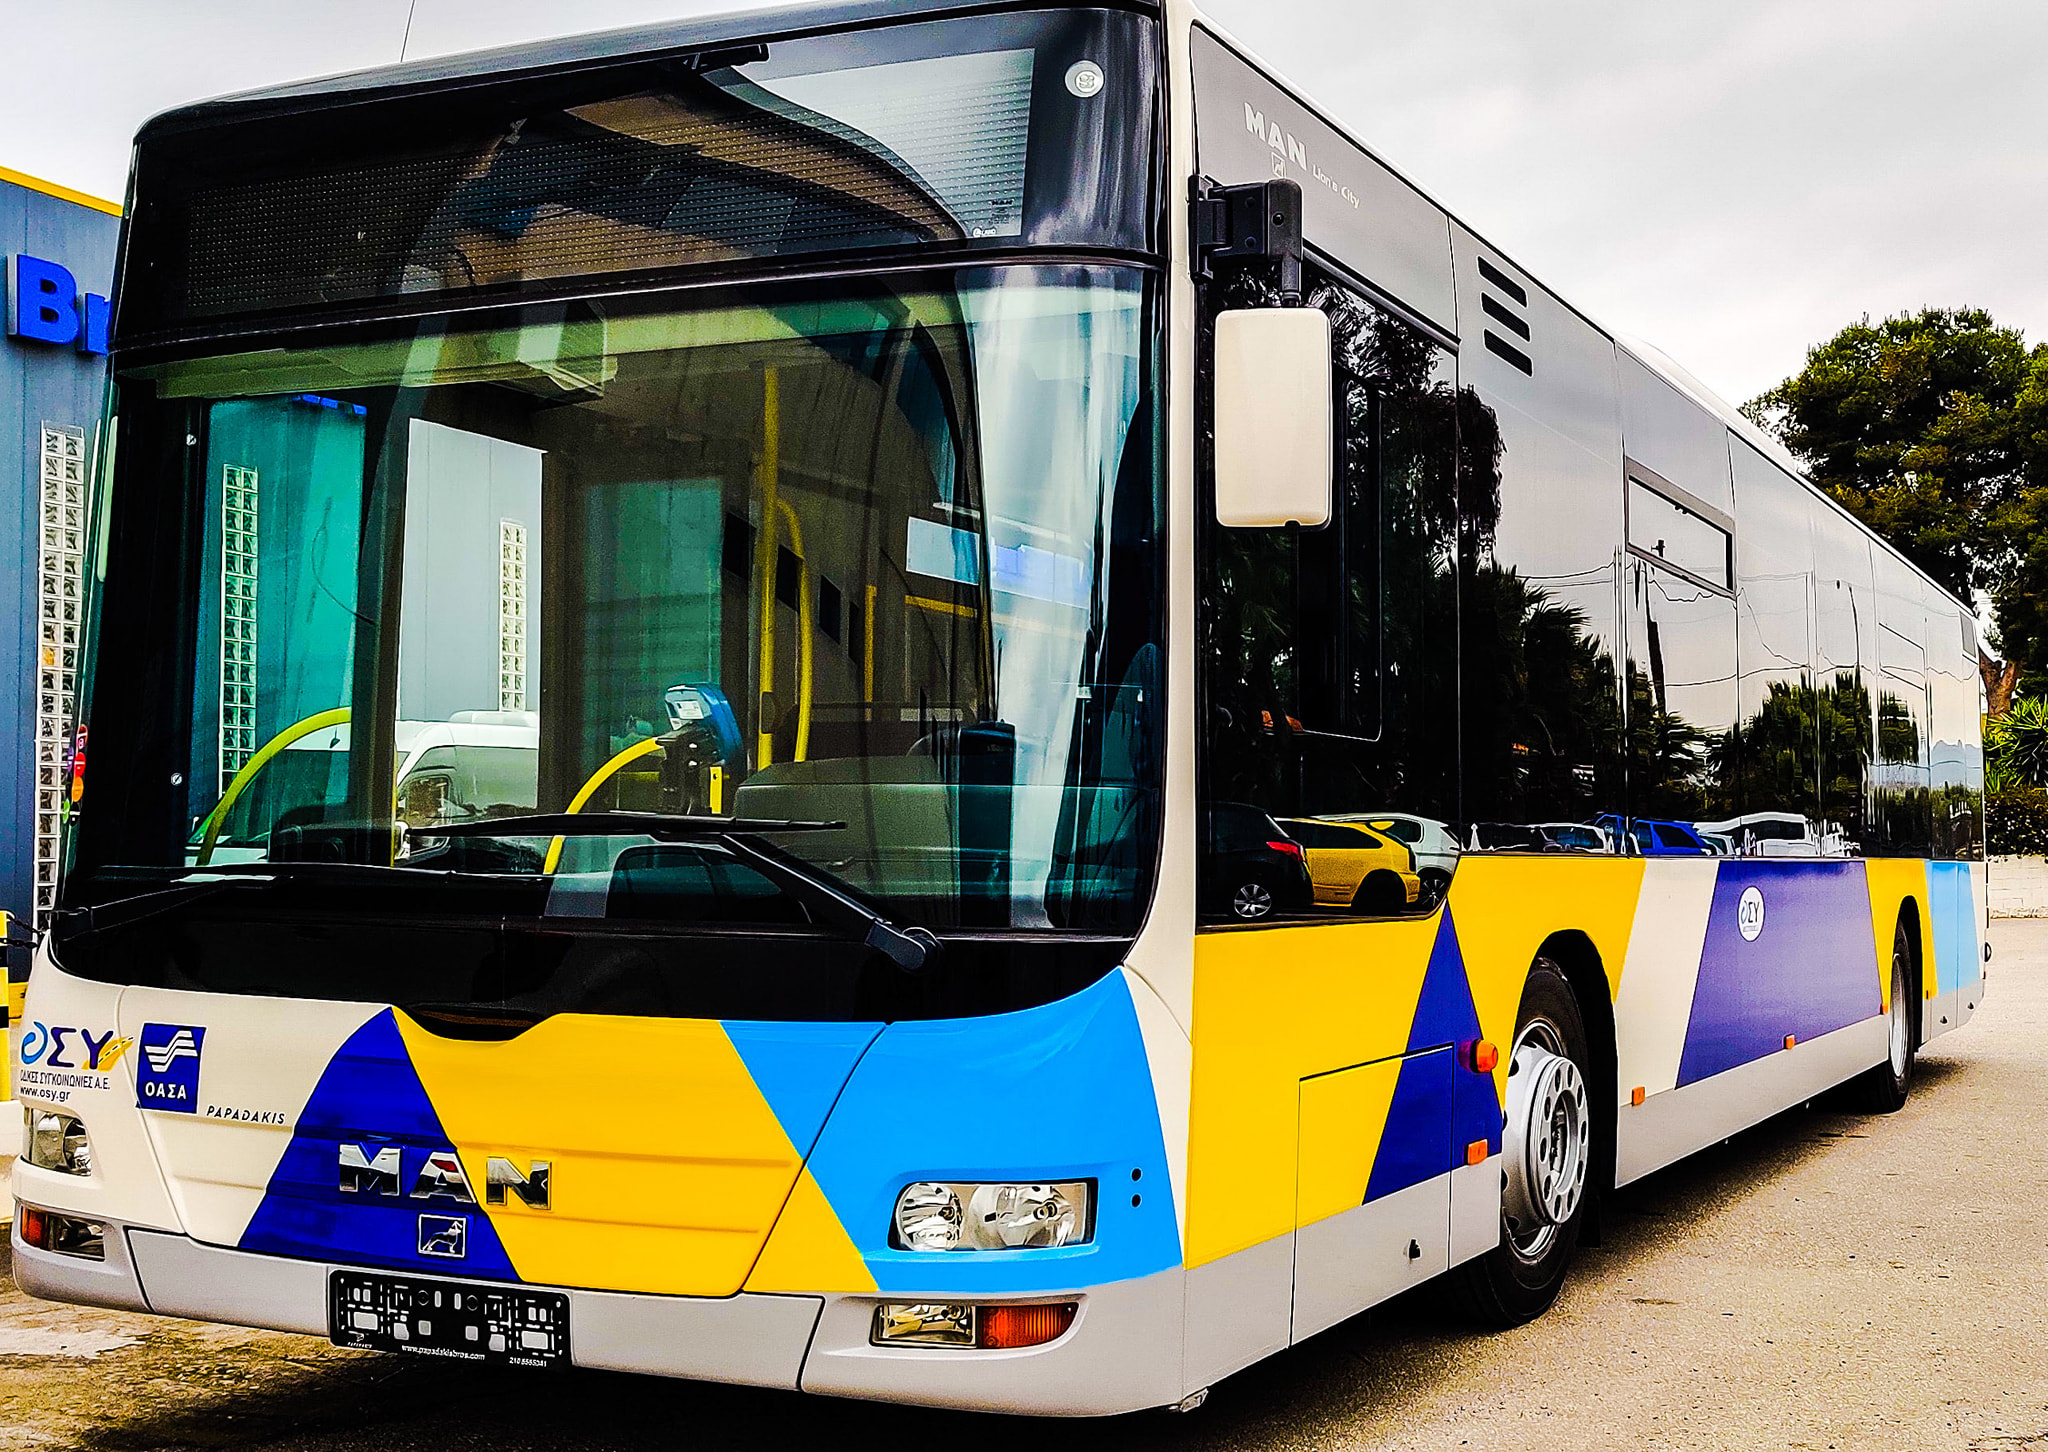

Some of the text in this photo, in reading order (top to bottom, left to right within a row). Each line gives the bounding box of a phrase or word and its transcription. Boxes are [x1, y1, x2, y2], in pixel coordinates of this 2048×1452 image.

[1244, 102, 1307, 171] MAN
[1341, 186, 1361, 209] City
[20, 1086, 71, 1102] www.osy.gr
[145, 1082, 187, 1100] ΟΑΣΑ
[206, 1105, 286, 1125] PAPADAKIS
[338, 1143, 552, 1210] MAN
